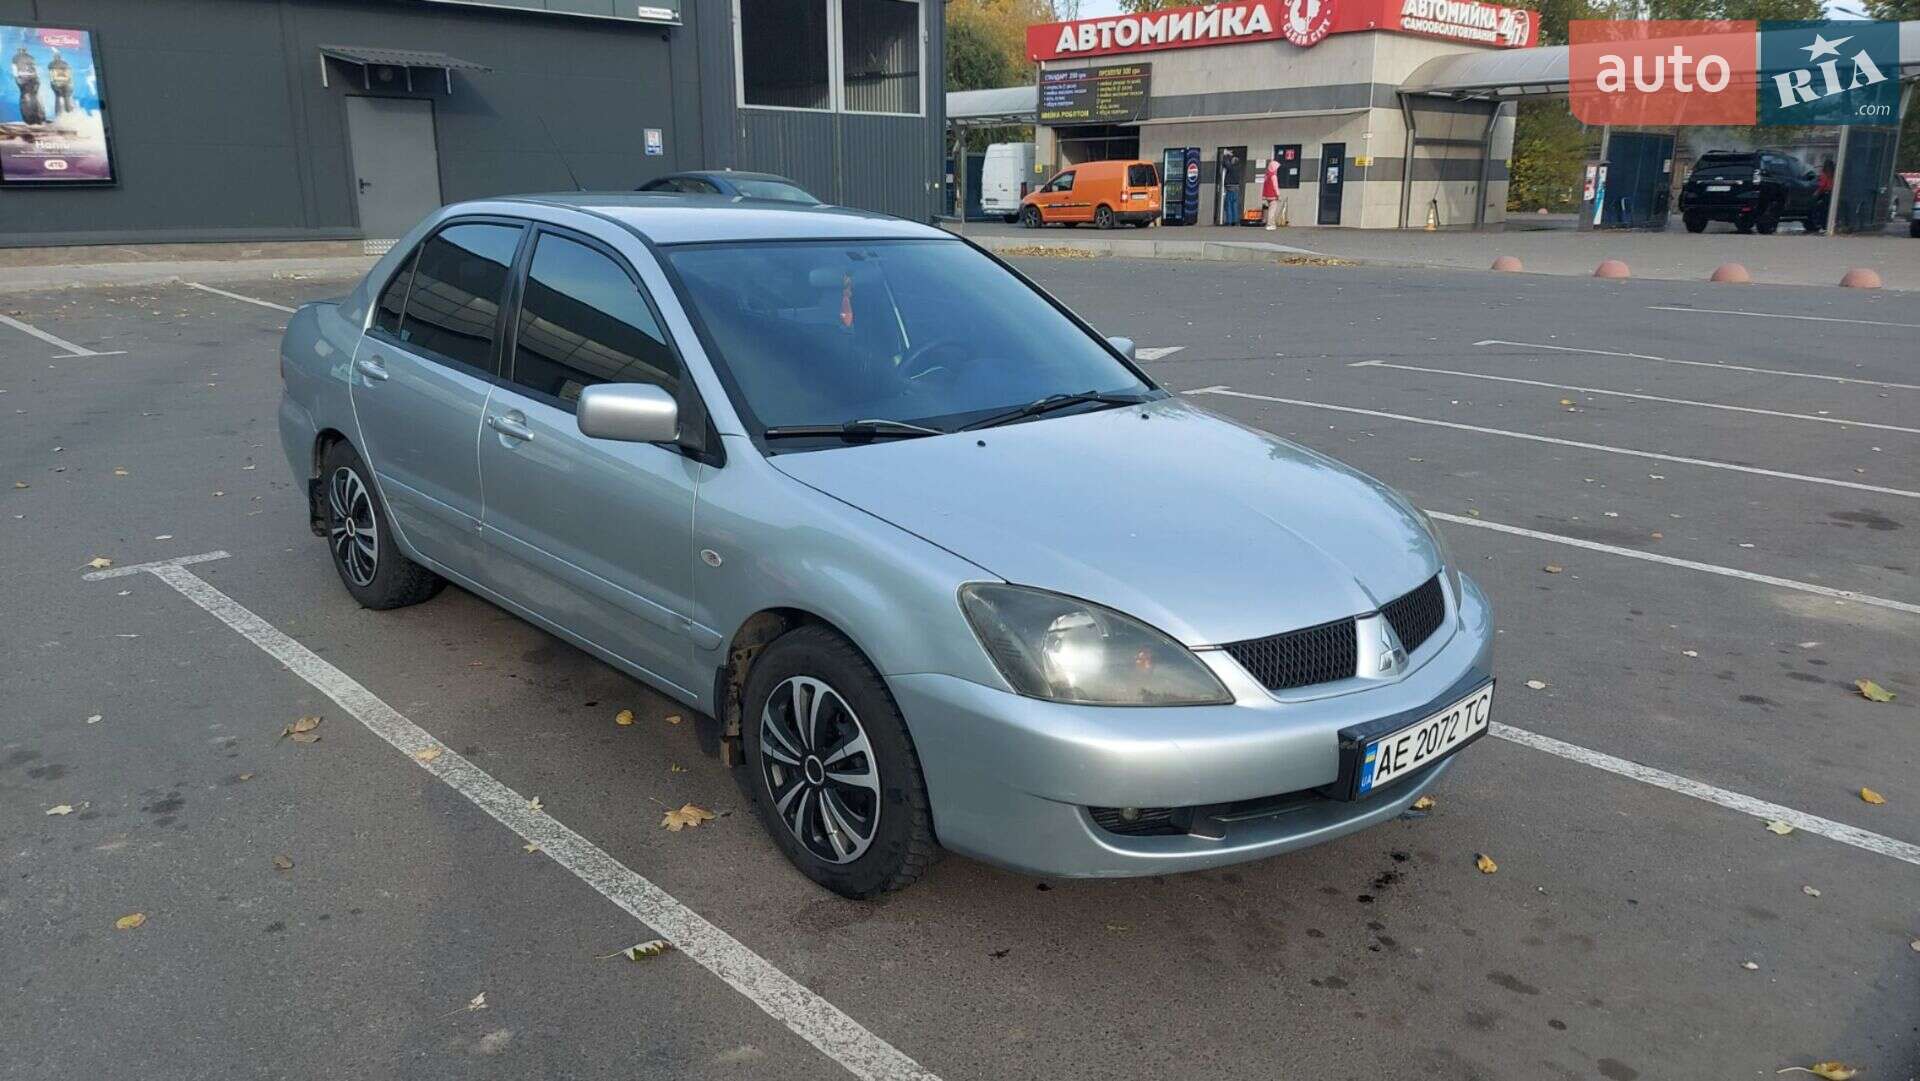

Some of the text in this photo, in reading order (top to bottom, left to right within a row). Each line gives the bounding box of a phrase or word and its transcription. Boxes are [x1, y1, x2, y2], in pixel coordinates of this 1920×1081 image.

[1055, 3, 1273, 53] АВТОМИЙКА
[1401, 0, 1498, 29] АВТОМИЙКА
[1376, 694, 1488, 781] AE 2072 TC
[1361, 774, 1372, 788] UA
